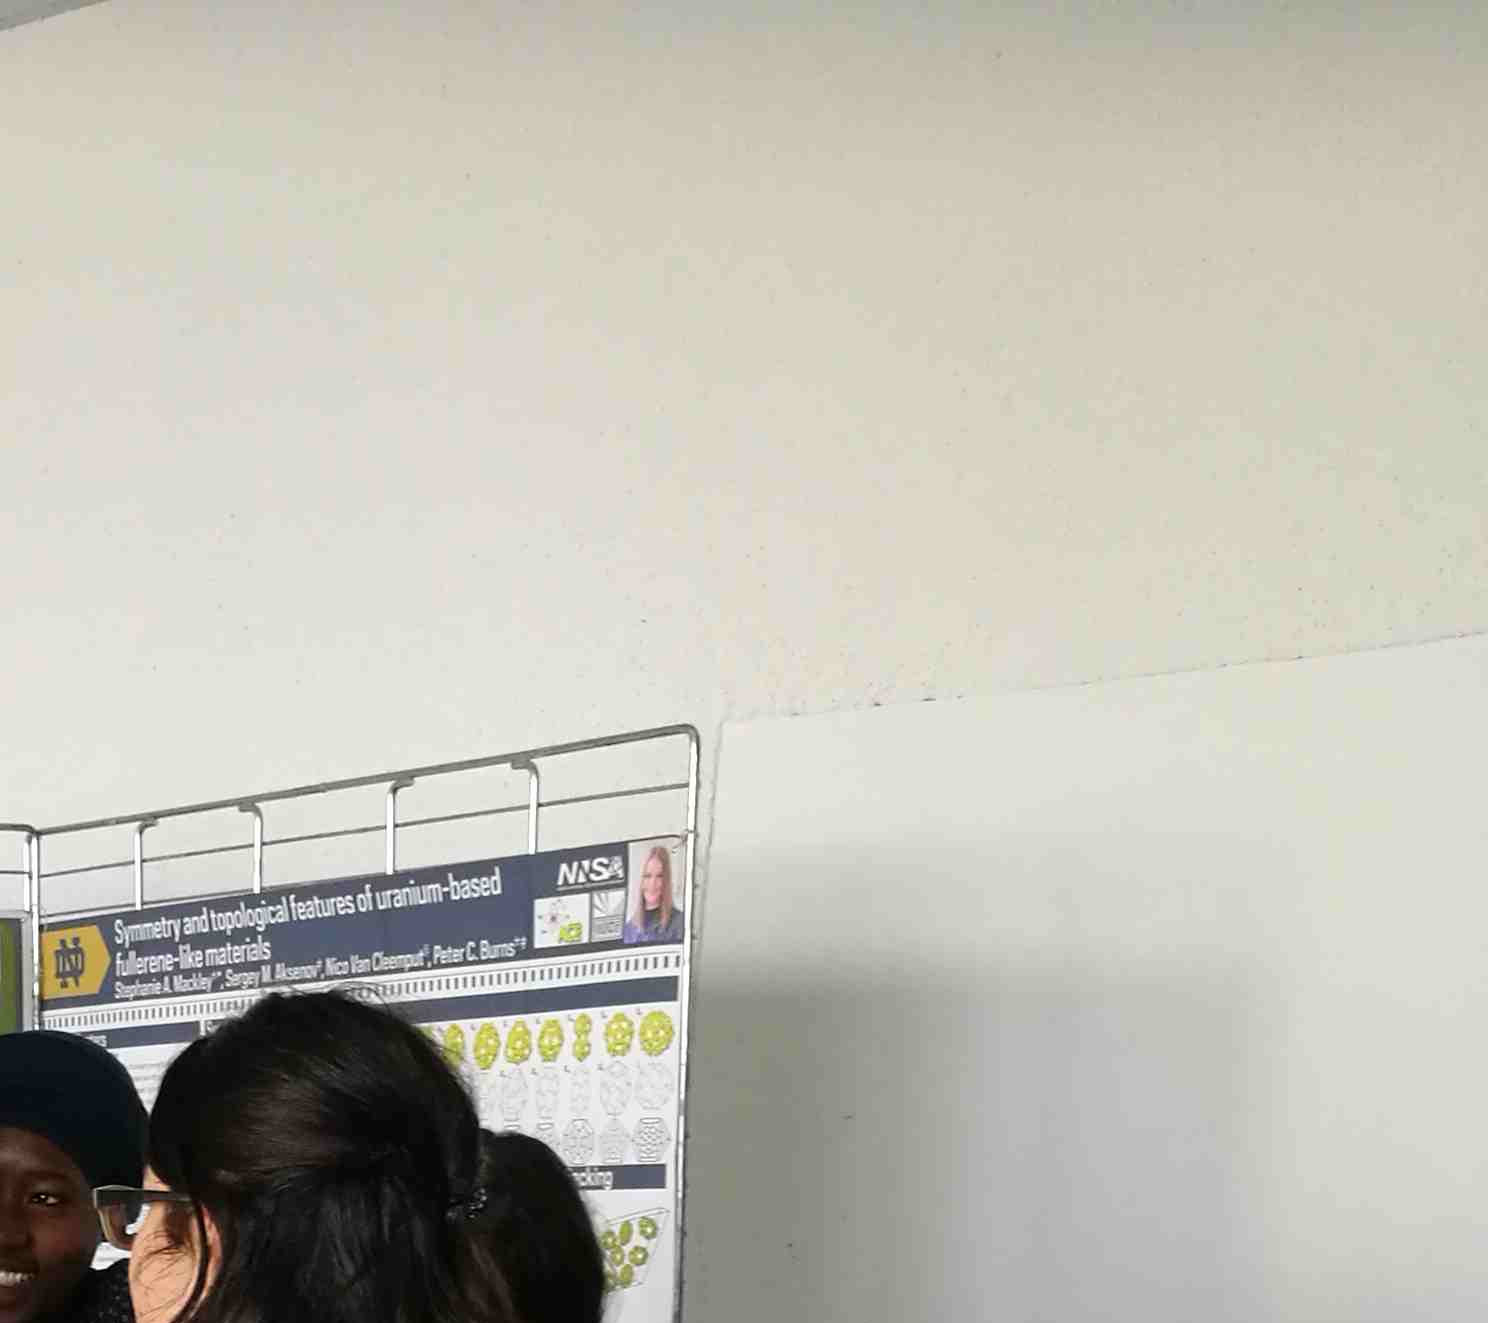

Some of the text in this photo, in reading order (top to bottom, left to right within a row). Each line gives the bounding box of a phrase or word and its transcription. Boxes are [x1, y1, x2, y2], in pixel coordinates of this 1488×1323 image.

[114, 866, 502, 947] Symmetry and topological features of uranium-based
[115, 936, 272, 976] fullerene-like materials
[433, 944, 465, 965] Peter
